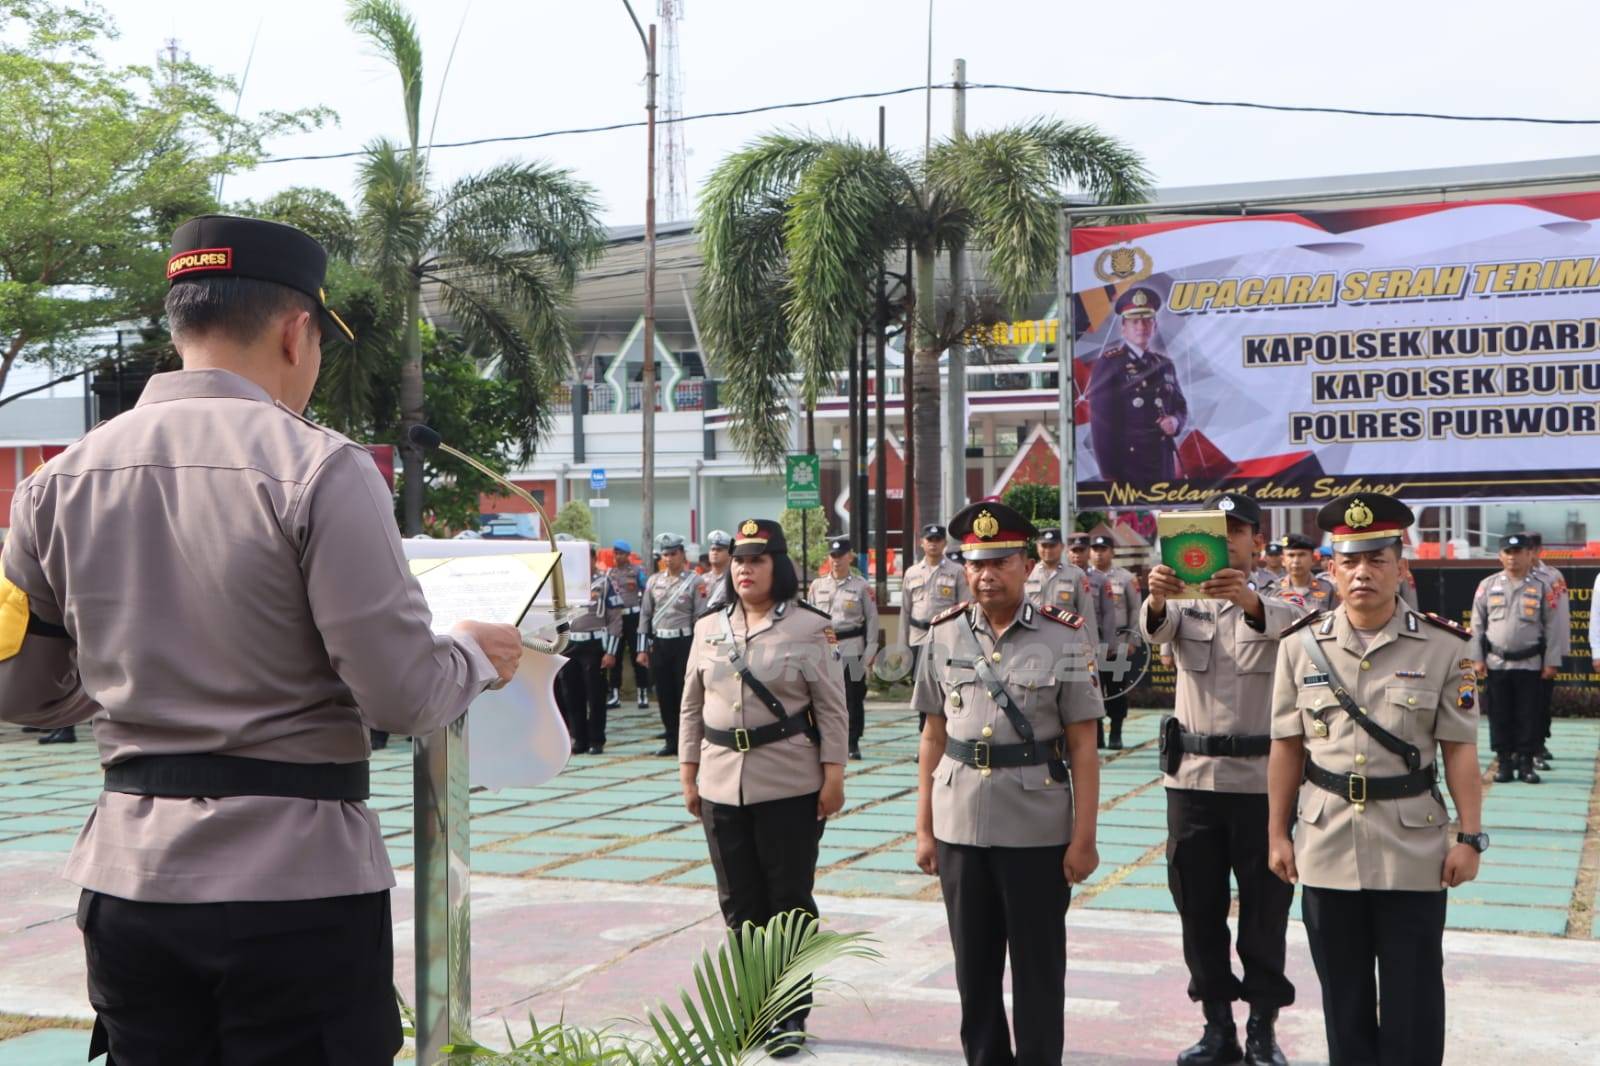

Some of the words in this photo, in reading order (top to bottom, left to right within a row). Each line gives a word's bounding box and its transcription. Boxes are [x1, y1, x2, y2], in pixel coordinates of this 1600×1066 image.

[169, 253, 227, 274] KAPOLRES
[1168, 272, 1337, 312] UPACARA
[1339, 265, 1468, 302] SERAH
[1245, 329, 1424, 366] KAPOLSEK
[1430, 319, 1600, 358] KUTOARJ
[1314, 366, 1498, 403] KAPOLSEK
[1291, 409, 1424, 443] POLRES
[1430, 403, 1600, 440] PURWOR
[1255, 480, 1301, 499] dan
